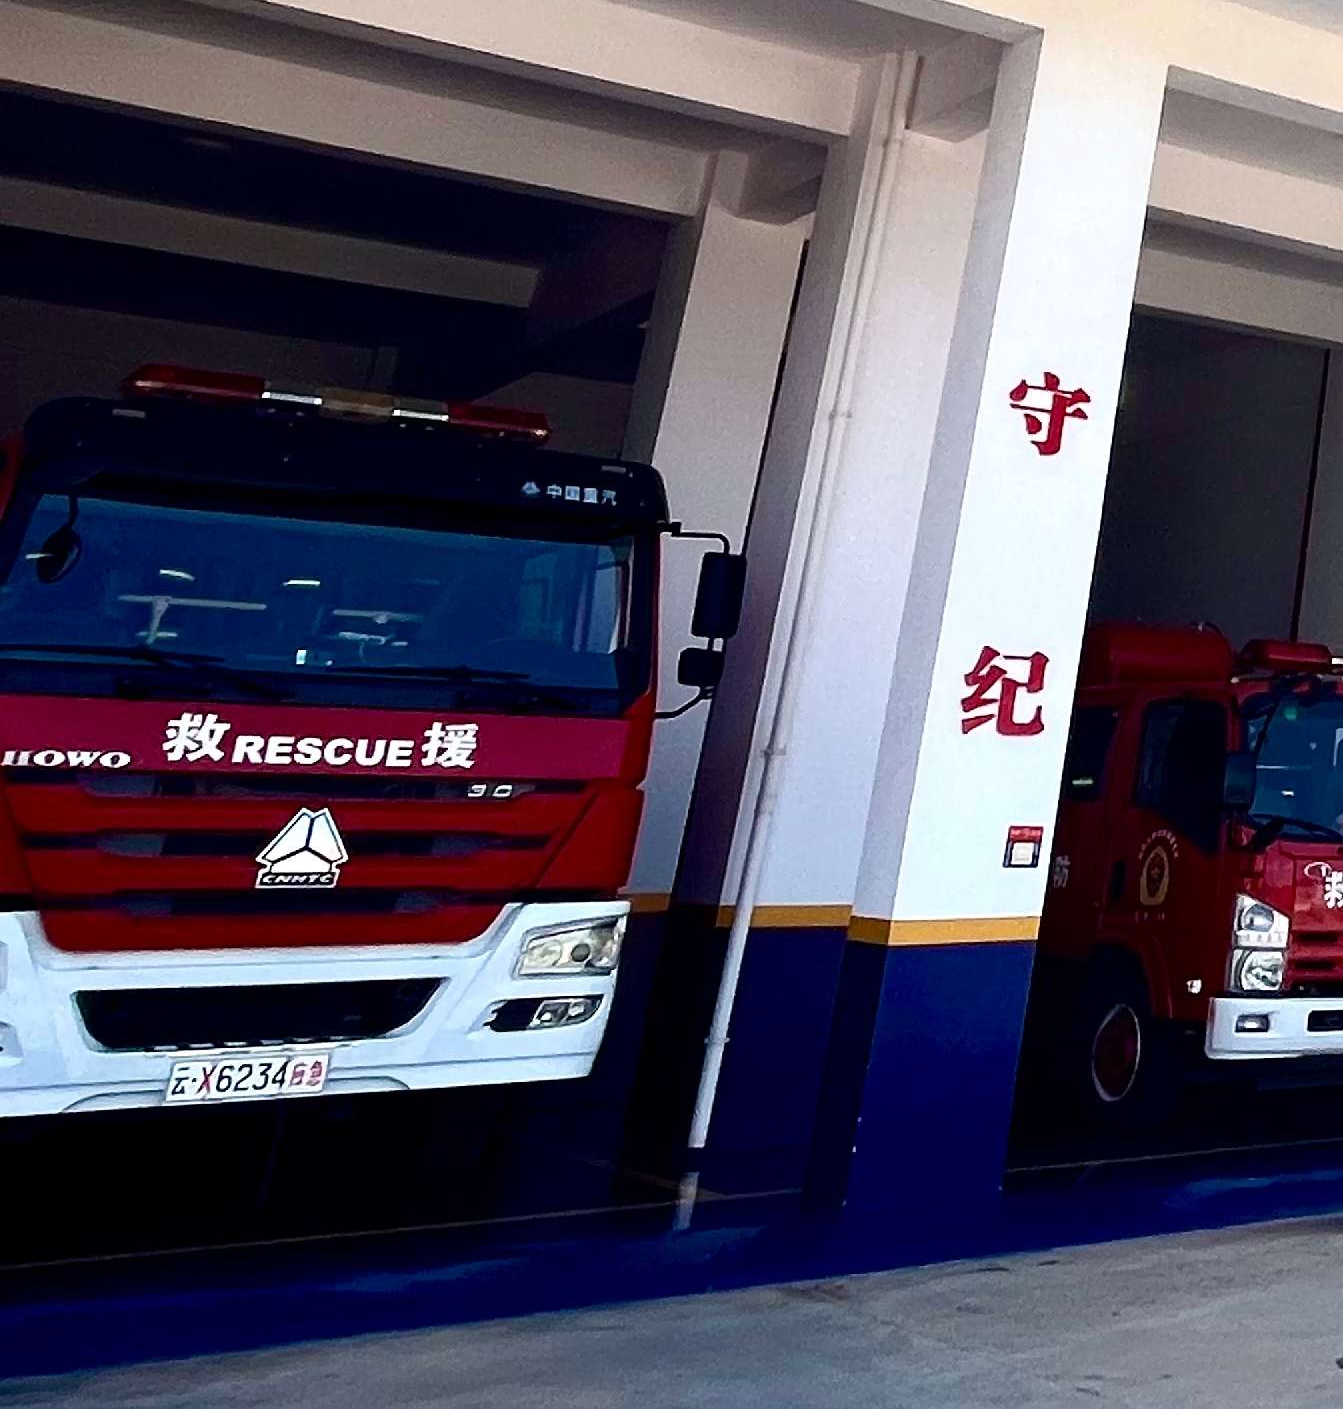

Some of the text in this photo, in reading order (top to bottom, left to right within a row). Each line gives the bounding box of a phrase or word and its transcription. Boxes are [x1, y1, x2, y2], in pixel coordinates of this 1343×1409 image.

[960, 371, 1090, 737] 守纪
[162, 712, 479, 769] 救 RESCUE 援
